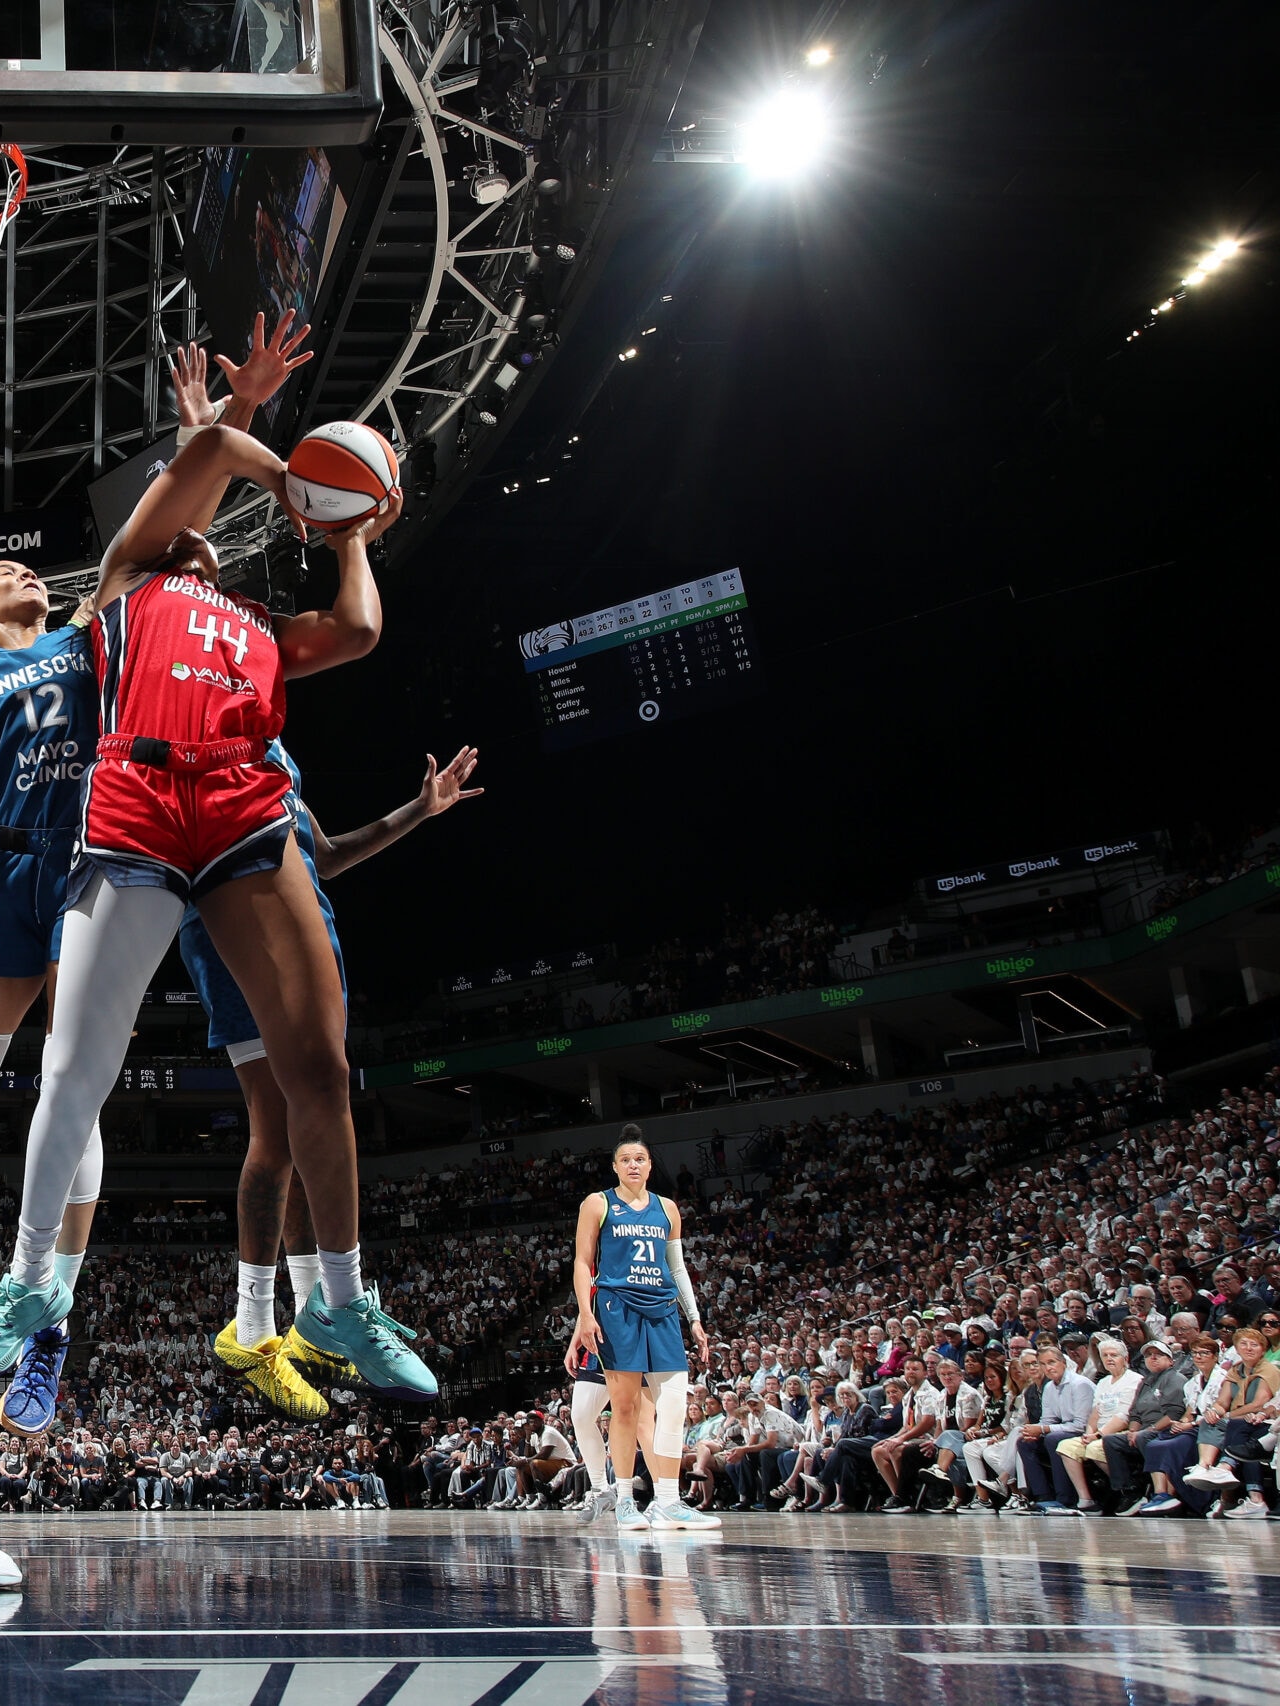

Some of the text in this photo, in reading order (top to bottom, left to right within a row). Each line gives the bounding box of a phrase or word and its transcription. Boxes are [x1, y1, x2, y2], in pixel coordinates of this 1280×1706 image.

[659, 594, 670, 602] AST
[723, 574, 735, 582] BLK
[163, 576, 276, 644] Washington
[598, 621, 613, 632] 26.7
[642, 610, 652, 618] 22
[663, 603, 672, 611] 17
[684, 597, 693, 605] 10
[624, 632, 636, 640] PTS
[654, 622, 666, 631] AST
[686, 609, 711, 621] FGM/A
[187, 609, 249, 665] 44
[548, 662, 577, 677] Howard
[192, 667, 255, 691] VANDA
[551, 676, 571, 688] Miles
[553, 685, 585, 699] Williams
[15, 683, 68, 733] 12
[556, 698, 581, 710] Coffey
[559, 707, 590, 722] McBride
[17, 740, 79, 769] MAYO
[15, 762, 85, 791] CLINIC
[986, 957, 1035, 976] bibigo
[820, 986, 864, 1003] bibigo
[672, 1013, 711, 1028] bibigo
[537, 1037, 572, 1052] bibigo
[414, 1059, 446, 1074] bibigo
[8, 1080, 14, 1088] 2
[920, 1080, 943, 1093] 106
[489, 1142, 506, 1153] 104
[611, 1223, 667, 1241] MINNESOTA
[632, 1240, 656, 1263] 21
[629, 1264, 662, 1277] MAYO
[626, 1274, 664, 1287] CLINIC
